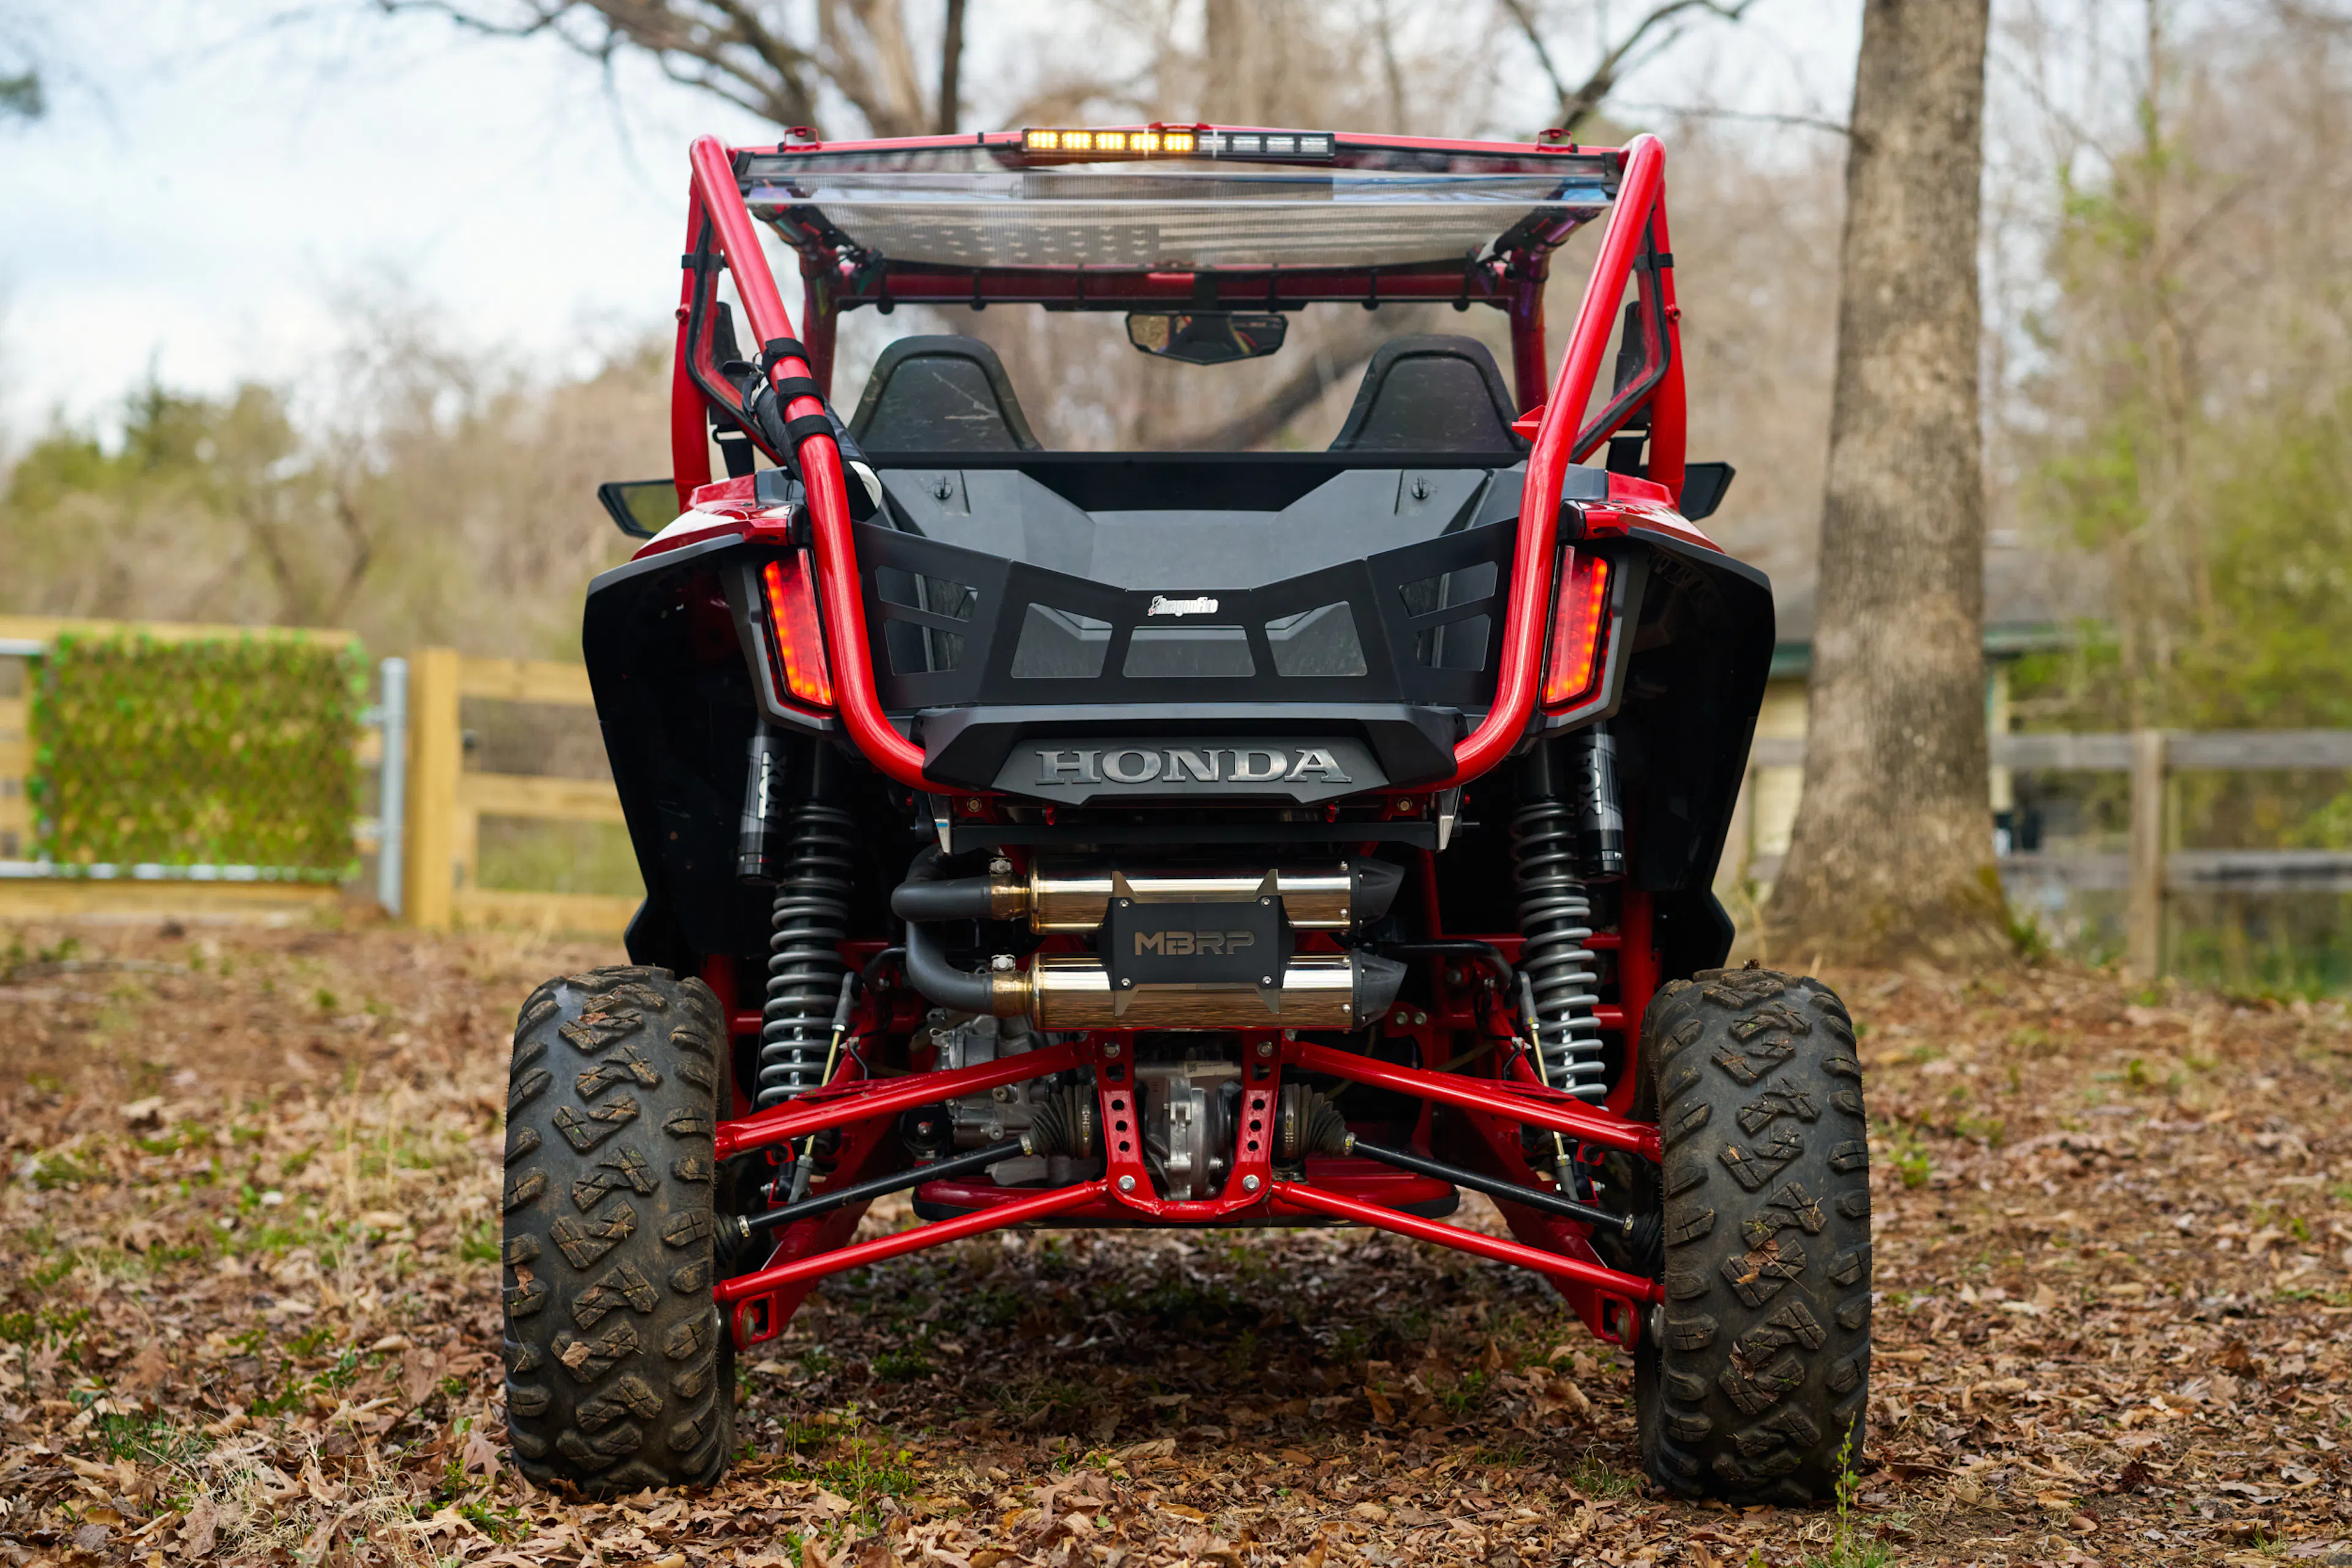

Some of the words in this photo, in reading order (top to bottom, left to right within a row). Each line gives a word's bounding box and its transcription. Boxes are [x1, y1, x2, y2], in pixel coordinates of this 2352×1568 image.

[758, 752, 788, 820] FOX
[1035, 747, 1352, 785] HONDA
[1575, 748, 1602, 815] FOX
[1134, 930, 1256, 956] MBRP
